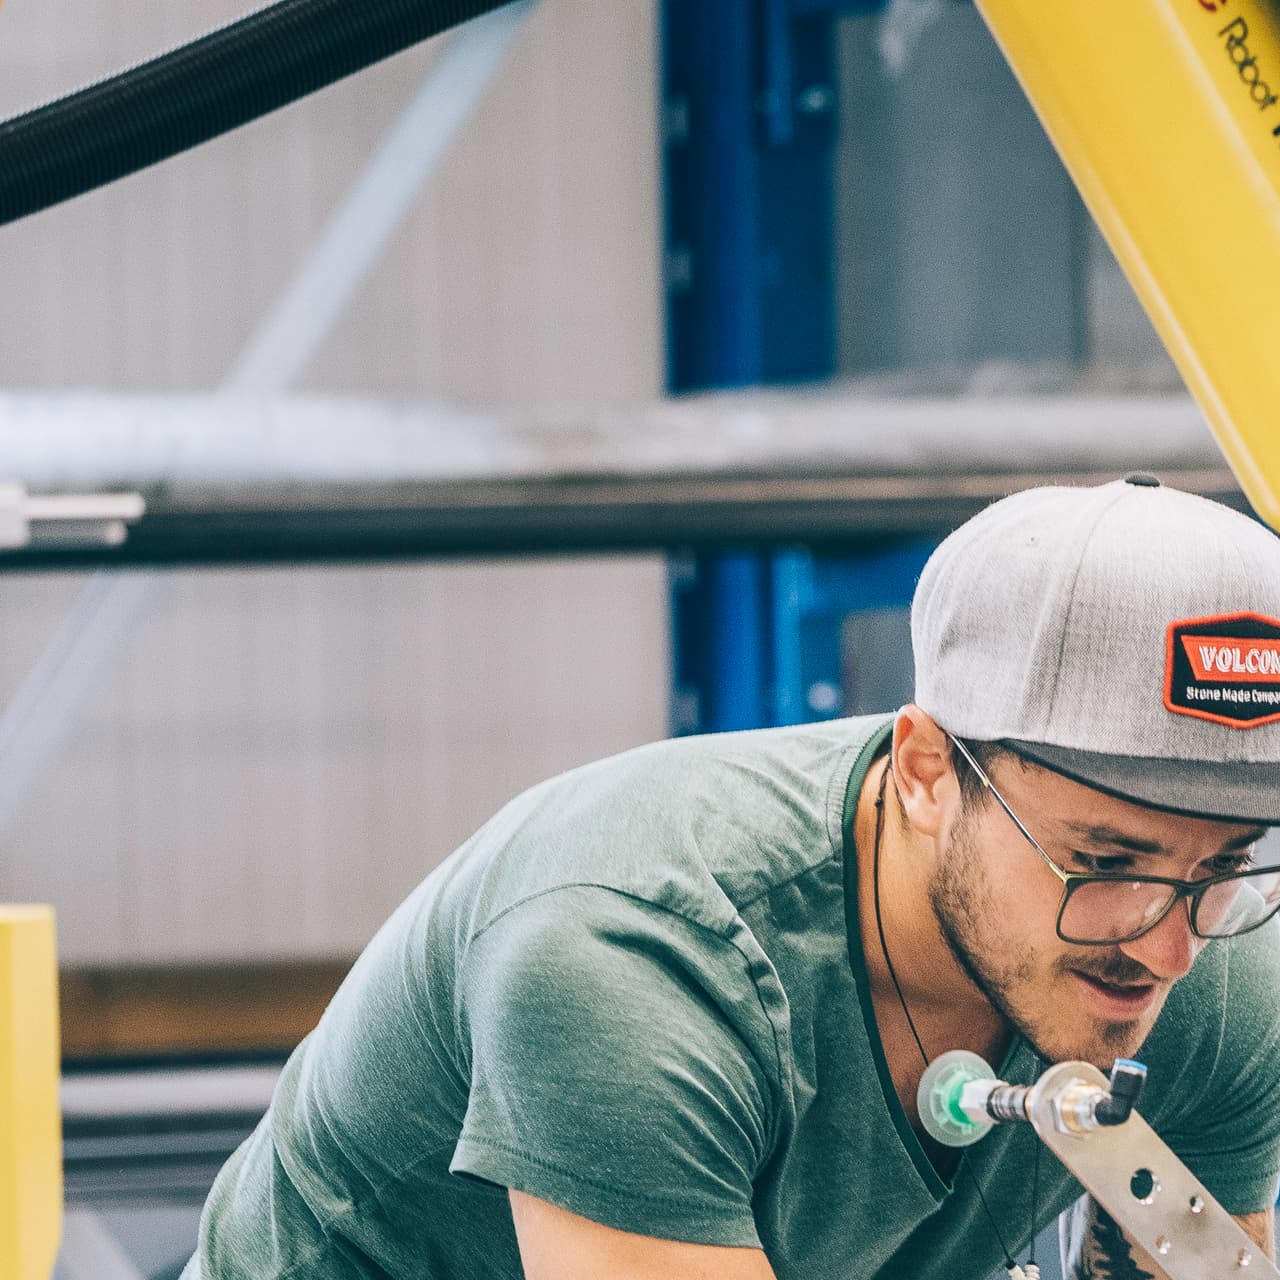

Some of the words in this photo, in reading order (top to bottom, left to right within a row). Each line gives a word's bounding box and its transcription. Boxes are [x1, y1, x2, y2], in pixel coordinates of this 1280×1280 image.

[1218, 16, 1279, 111] Robot
[1186, 686, 1221, 701] Stone
[1222, 688, 1251, 703] Made
